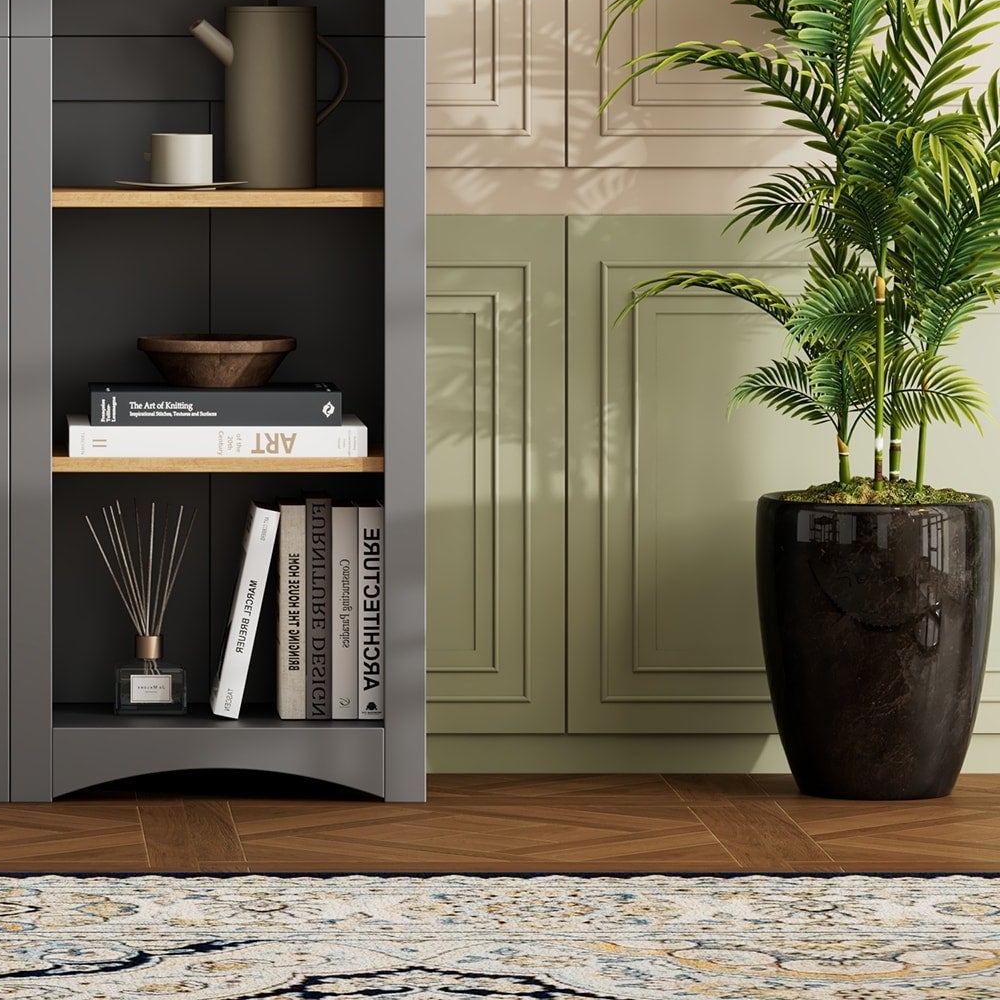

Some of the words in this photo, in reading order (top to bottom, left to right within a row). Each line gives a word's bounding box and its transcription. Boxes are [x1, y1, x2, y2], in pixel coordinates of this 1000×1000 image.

[129, 401, 143, 410] The
[144, 401, 156, 410] Art
[156, 401, 165, 410] of
[165, 401, 193, 411] Knitting
[251, 433, 297, 454] ART
